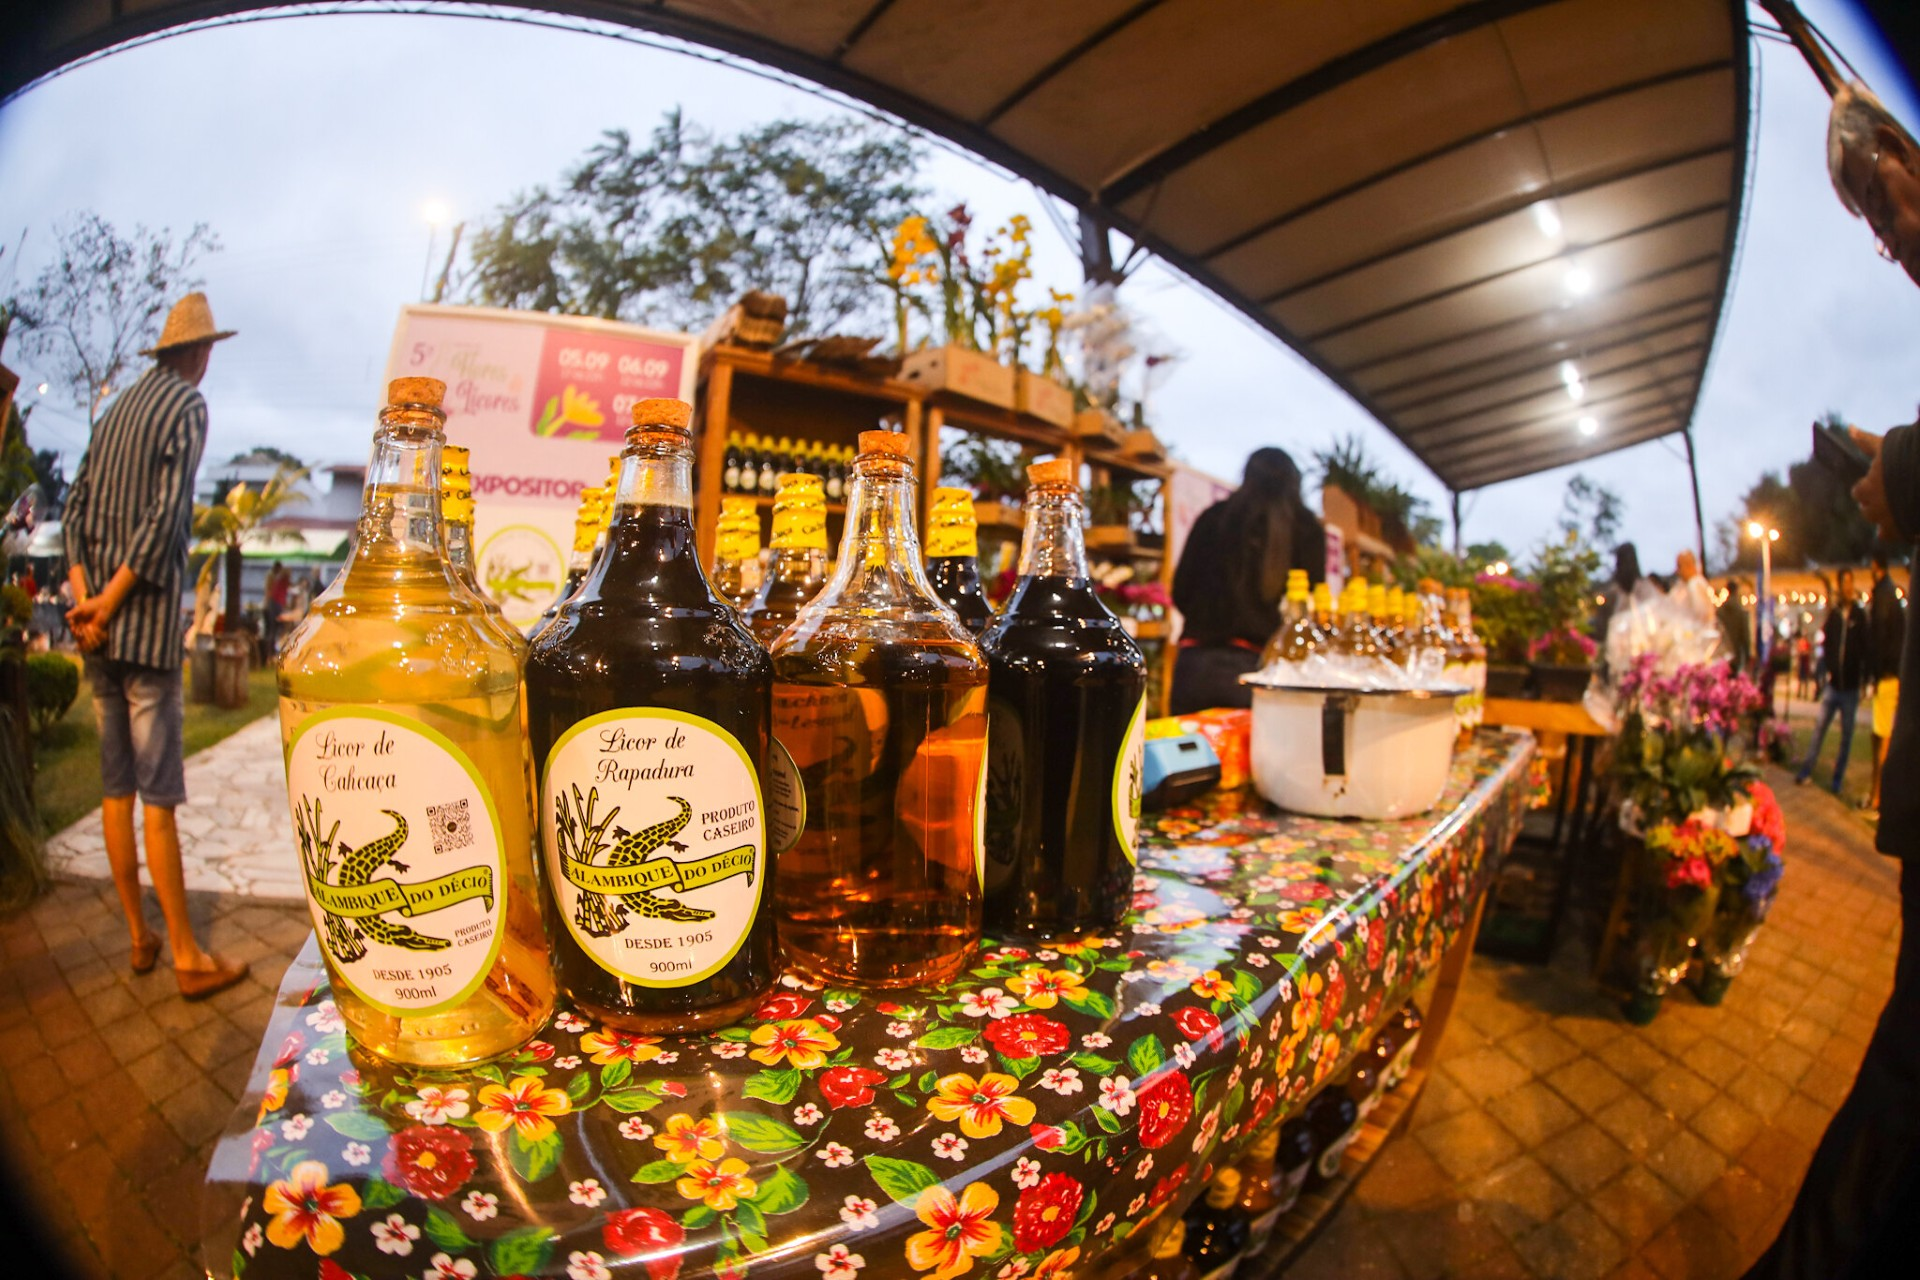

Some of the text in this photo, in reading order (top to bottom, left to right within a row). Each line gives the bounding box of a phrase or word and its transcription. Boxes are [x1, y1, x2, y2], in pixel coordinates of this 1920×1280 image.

[558, 347, 610, 371] 05.09
[617, 355, 670, 378] 06.09
[470, 474, 587, 501] XPOSITOR
[315, 729, 395, 760] Licor de
[599, 727, 686, 753] Licor de
[318, 764, 397, 793] Cahcaça
[595, 758, 695, 790] Rapadura
[701, 799, 756, 825] PRODUTO
[703, 816, 756, 842] CASEIRO
[571, 854, 752, 889] ALAMBIQUE DO DÉCIO
[314, 875, 488, 911] ALAMBIQUE DO DÉCIO
[454, 918, 492, 938] PRODUTO
[457, 928, 493, 948] CASEIRO
[624, 930, 713, 950] DESDE 1905
[373, 963, 453, 982] DESDE 1905
[649, 958, 693, 973] 900ml
[394, 984, 437, 1000] 900ml
